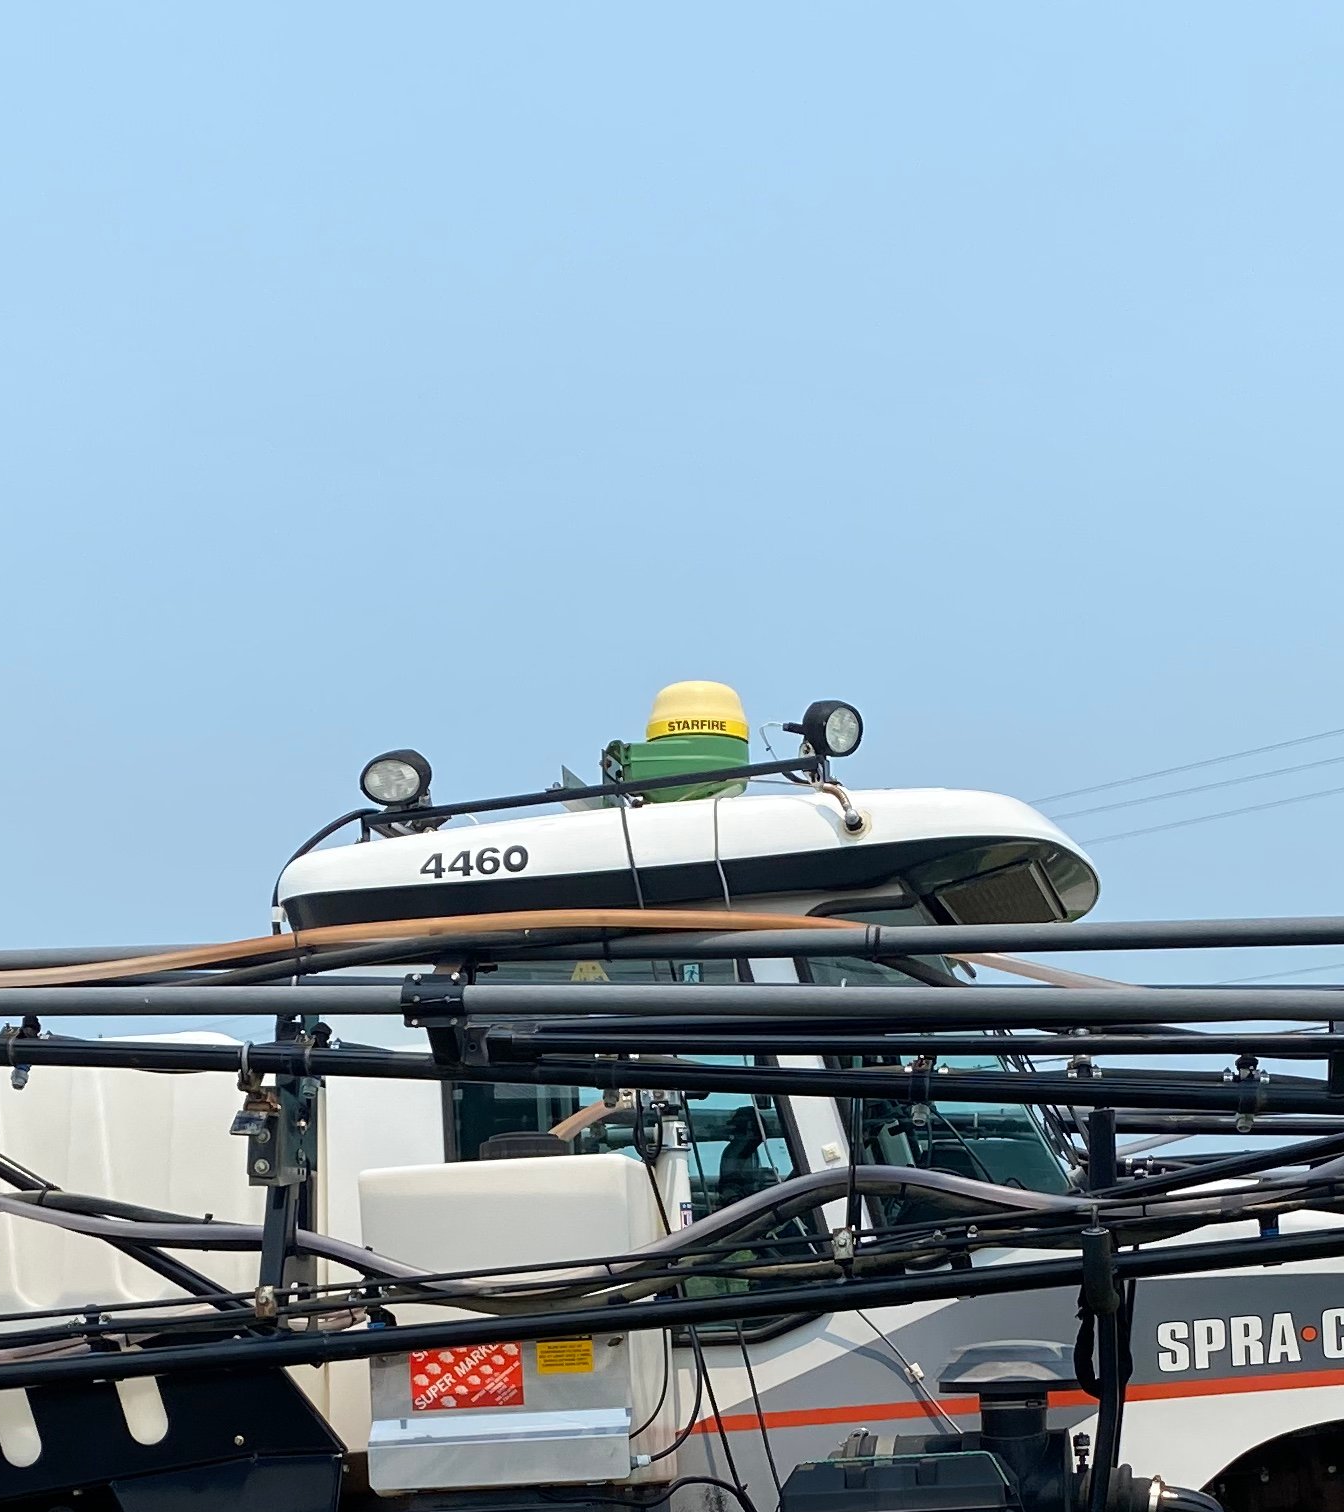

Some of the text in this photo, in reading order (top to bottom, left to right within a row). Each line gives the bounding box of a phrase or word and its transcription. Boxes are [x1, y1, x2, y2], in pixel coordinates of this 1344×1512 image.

[667, 719, 727, 732] STARFIRE
[420, 844, 529, 878] 4460
[414, 1373, 456, 1409] SUPER
